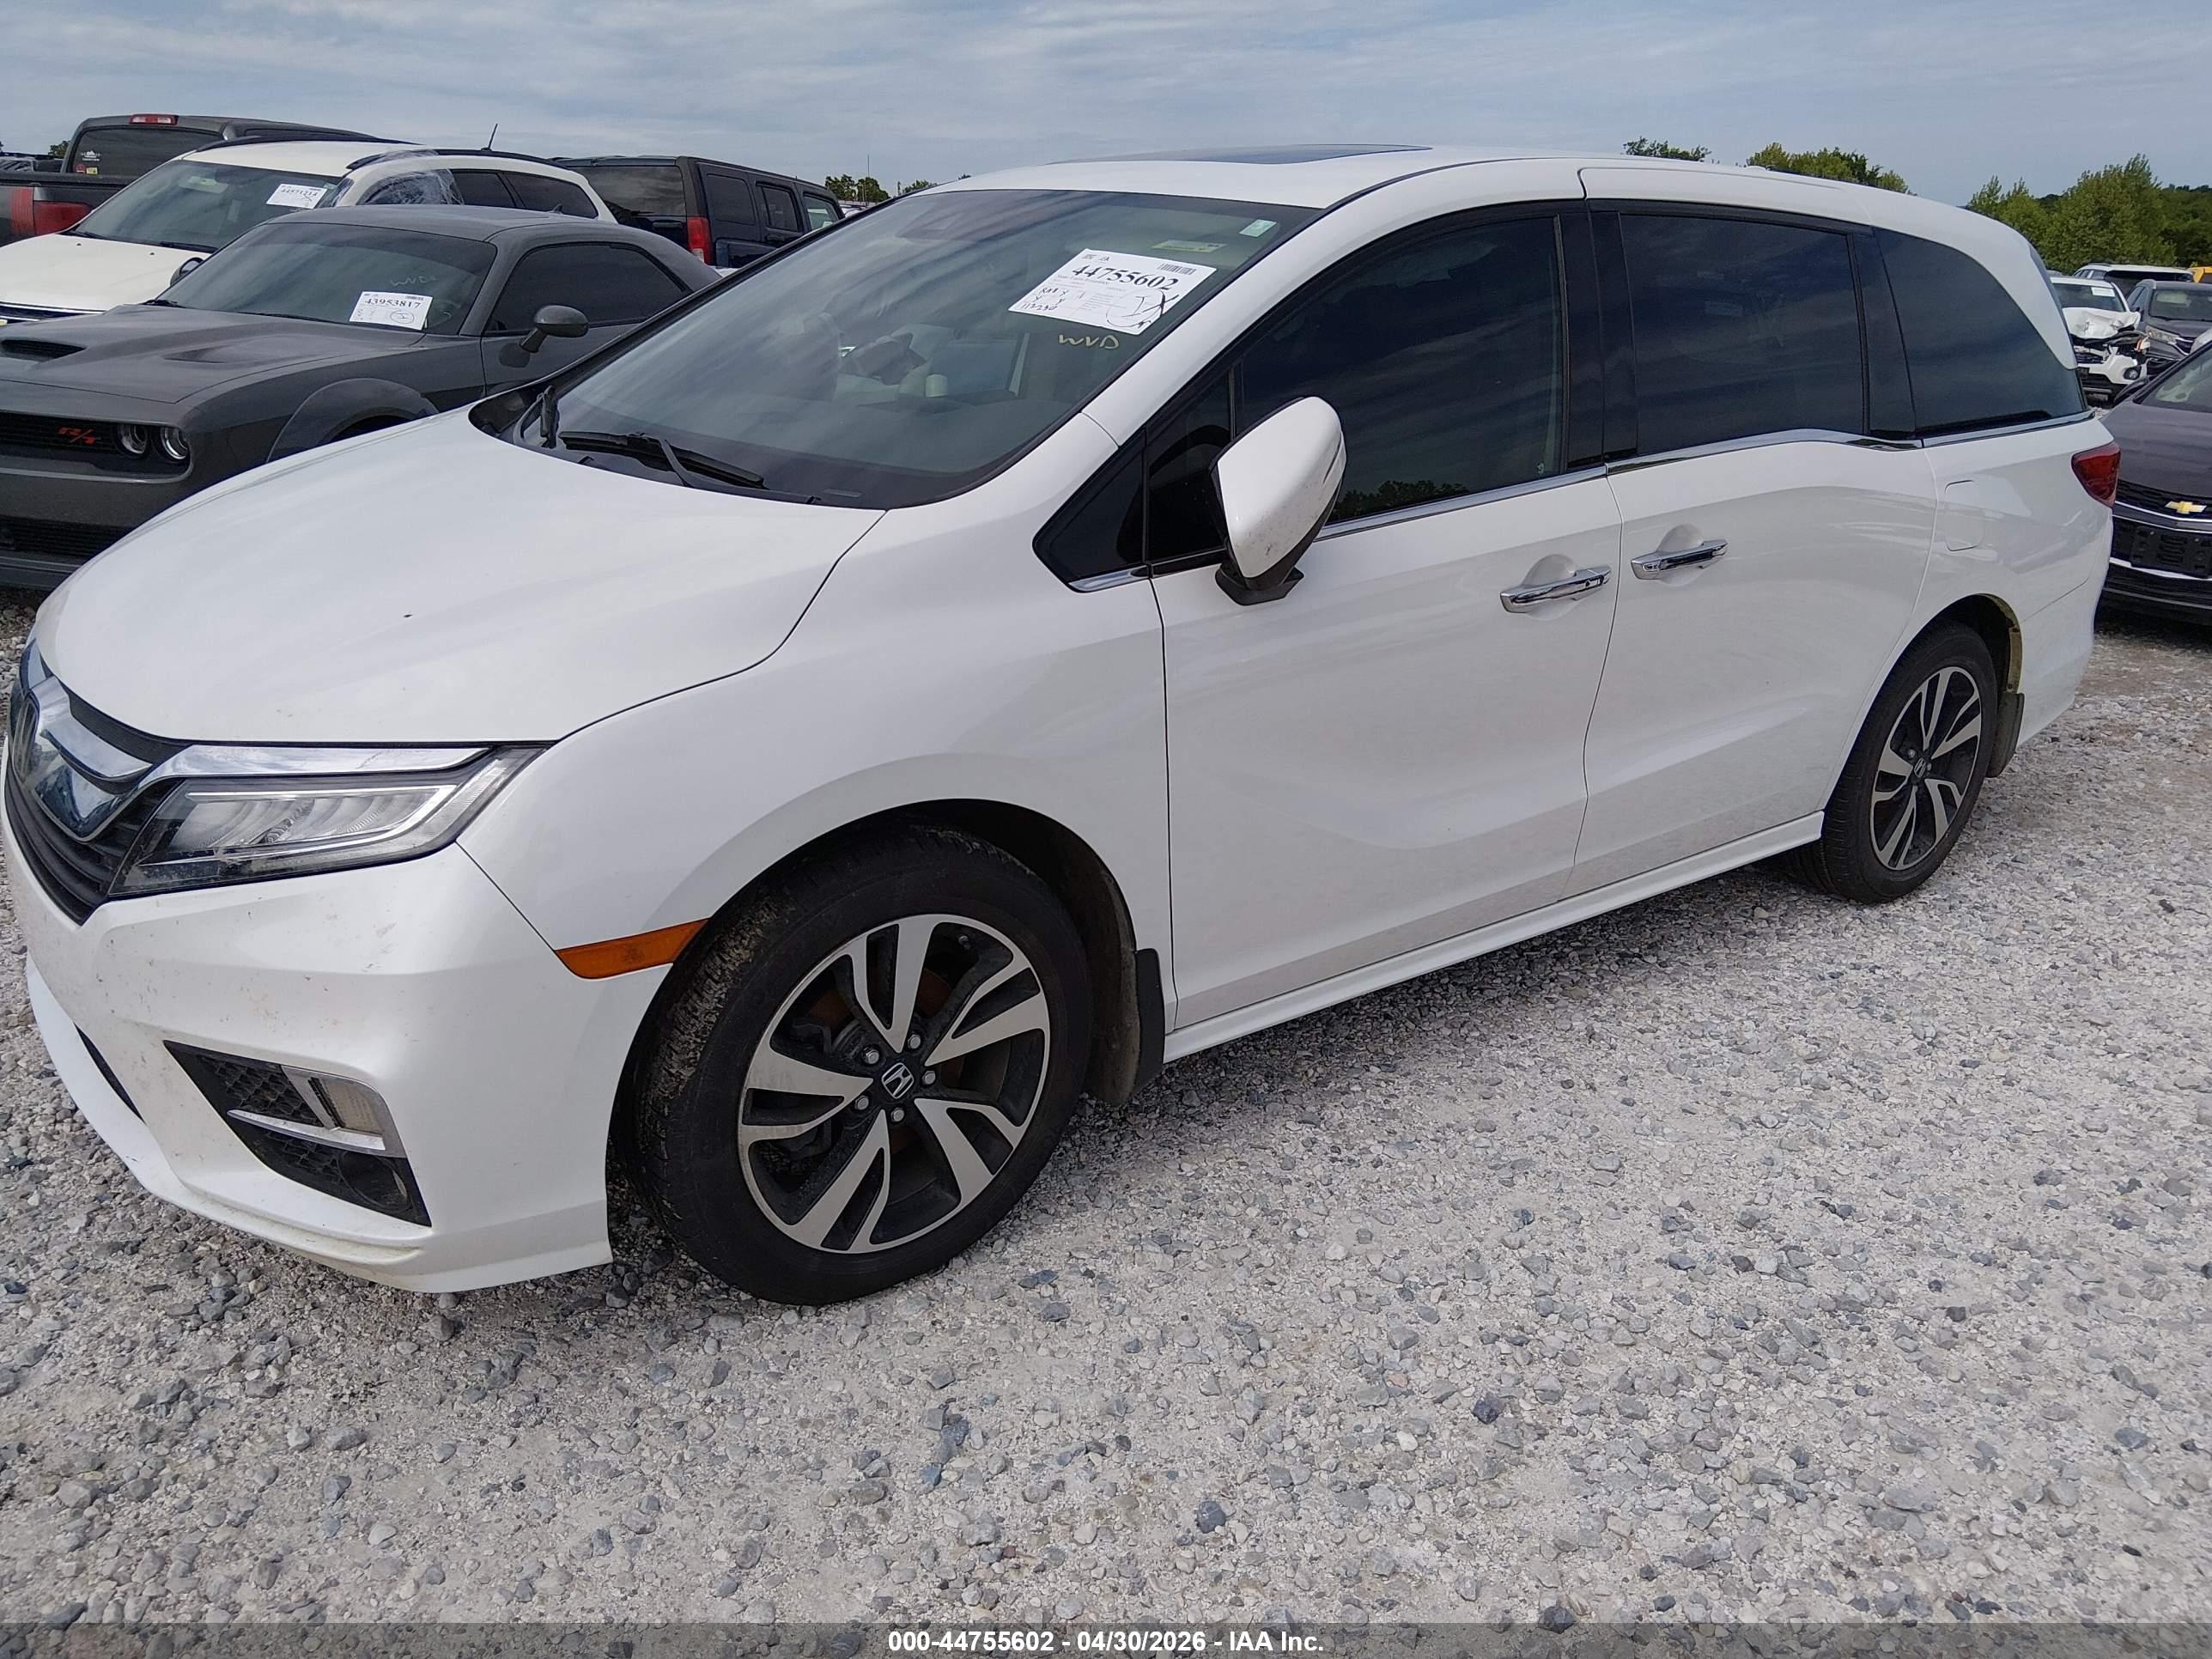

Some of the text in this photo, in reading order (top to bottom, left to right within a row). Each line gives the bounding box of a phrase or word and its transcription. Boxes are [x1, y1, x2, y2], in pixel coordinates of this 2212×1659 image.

[1073, 265, 1179, 290] 44755602
[364, 298, 422, 309] 43953817
[58, 426, 98, 445] R/T
